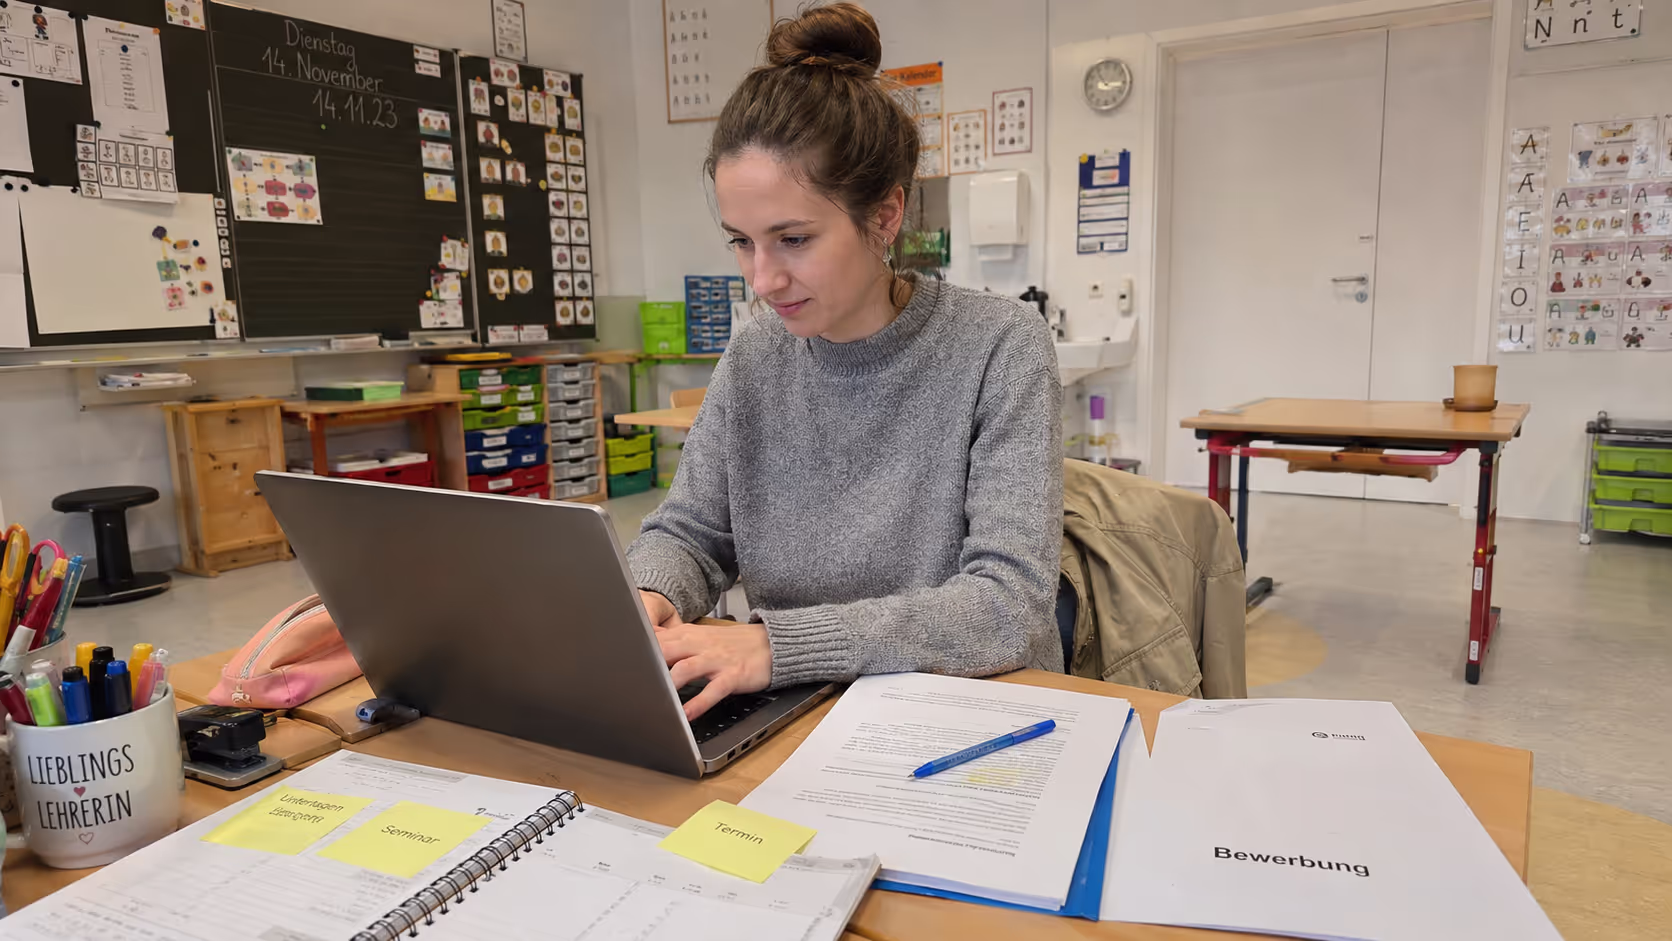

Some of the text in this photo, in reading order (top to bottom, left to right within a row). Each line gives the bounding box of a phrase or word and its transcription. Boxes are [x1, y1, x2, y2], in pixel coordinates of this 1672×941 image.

[1534, 8, 1624, 39] N n t
[284, 19, 356, 72] Dienstag
[262, 46, 384, 93] 14. November
[312, 88, 398, 129] 14.11.23
[1520, 134, 1537, 155] A
[1518, 211, 1531, 232] E
[1516, 249, 1526, 269] I
[1511, 287, 1527, 307] O
[1509, 324, 1524, 344] U
[28, 743, 134, 785] LIEBLINGS
[37, 789, 132, 830] LEHRERIN
[381, 824, 440, 845] Seminar
[714, 821, 764, 845] Termin
[1213, 846, 1370, 877] Bewerbung
